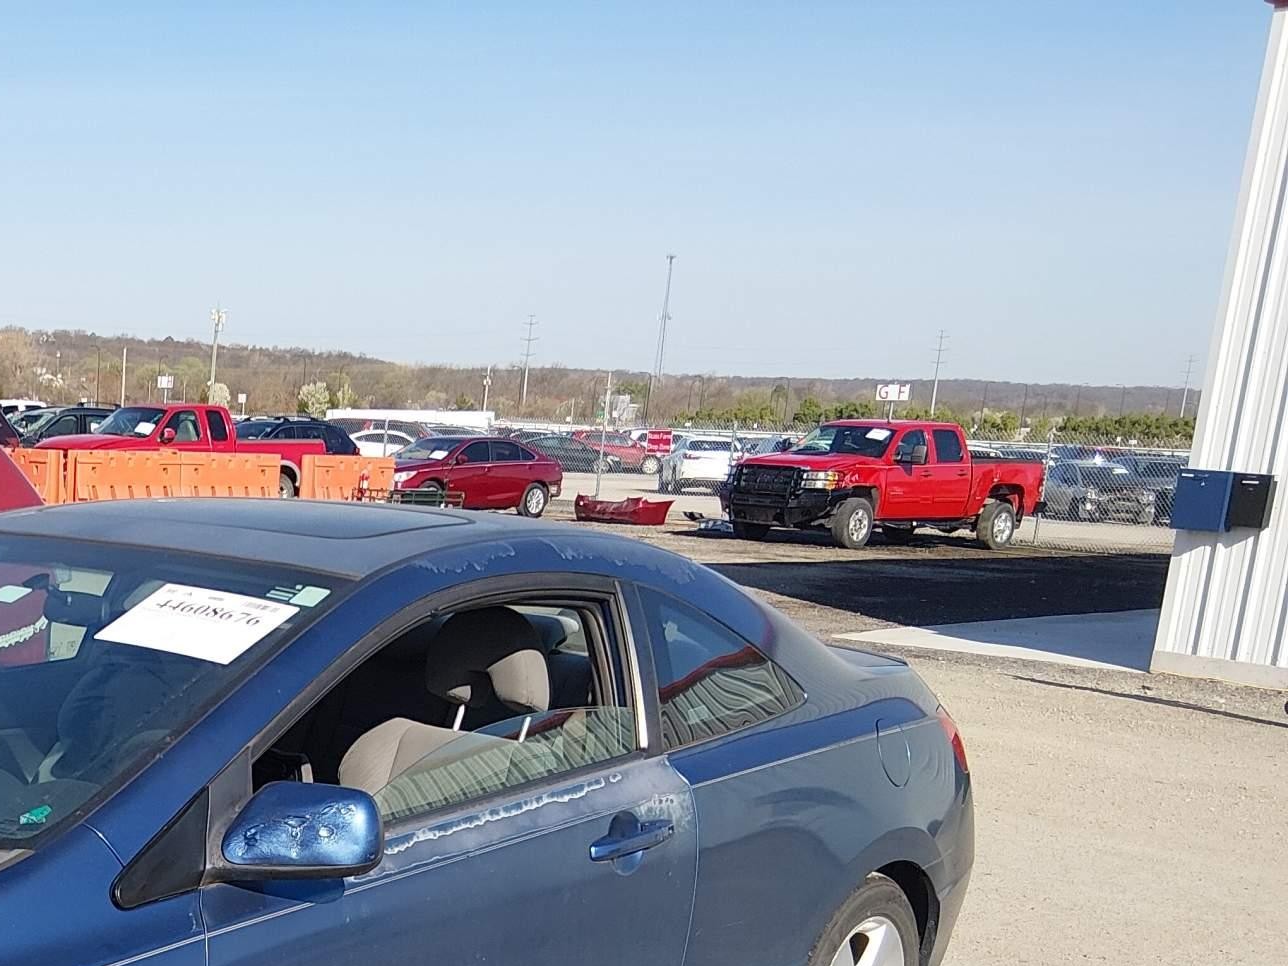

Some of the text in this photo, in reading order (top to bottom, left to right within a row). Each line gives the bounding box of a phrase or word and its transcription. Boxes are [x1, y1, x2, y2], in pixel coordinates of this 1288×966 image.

[878, 384, 907, 400] G F
[155, 598, 262, 627] 44608676
